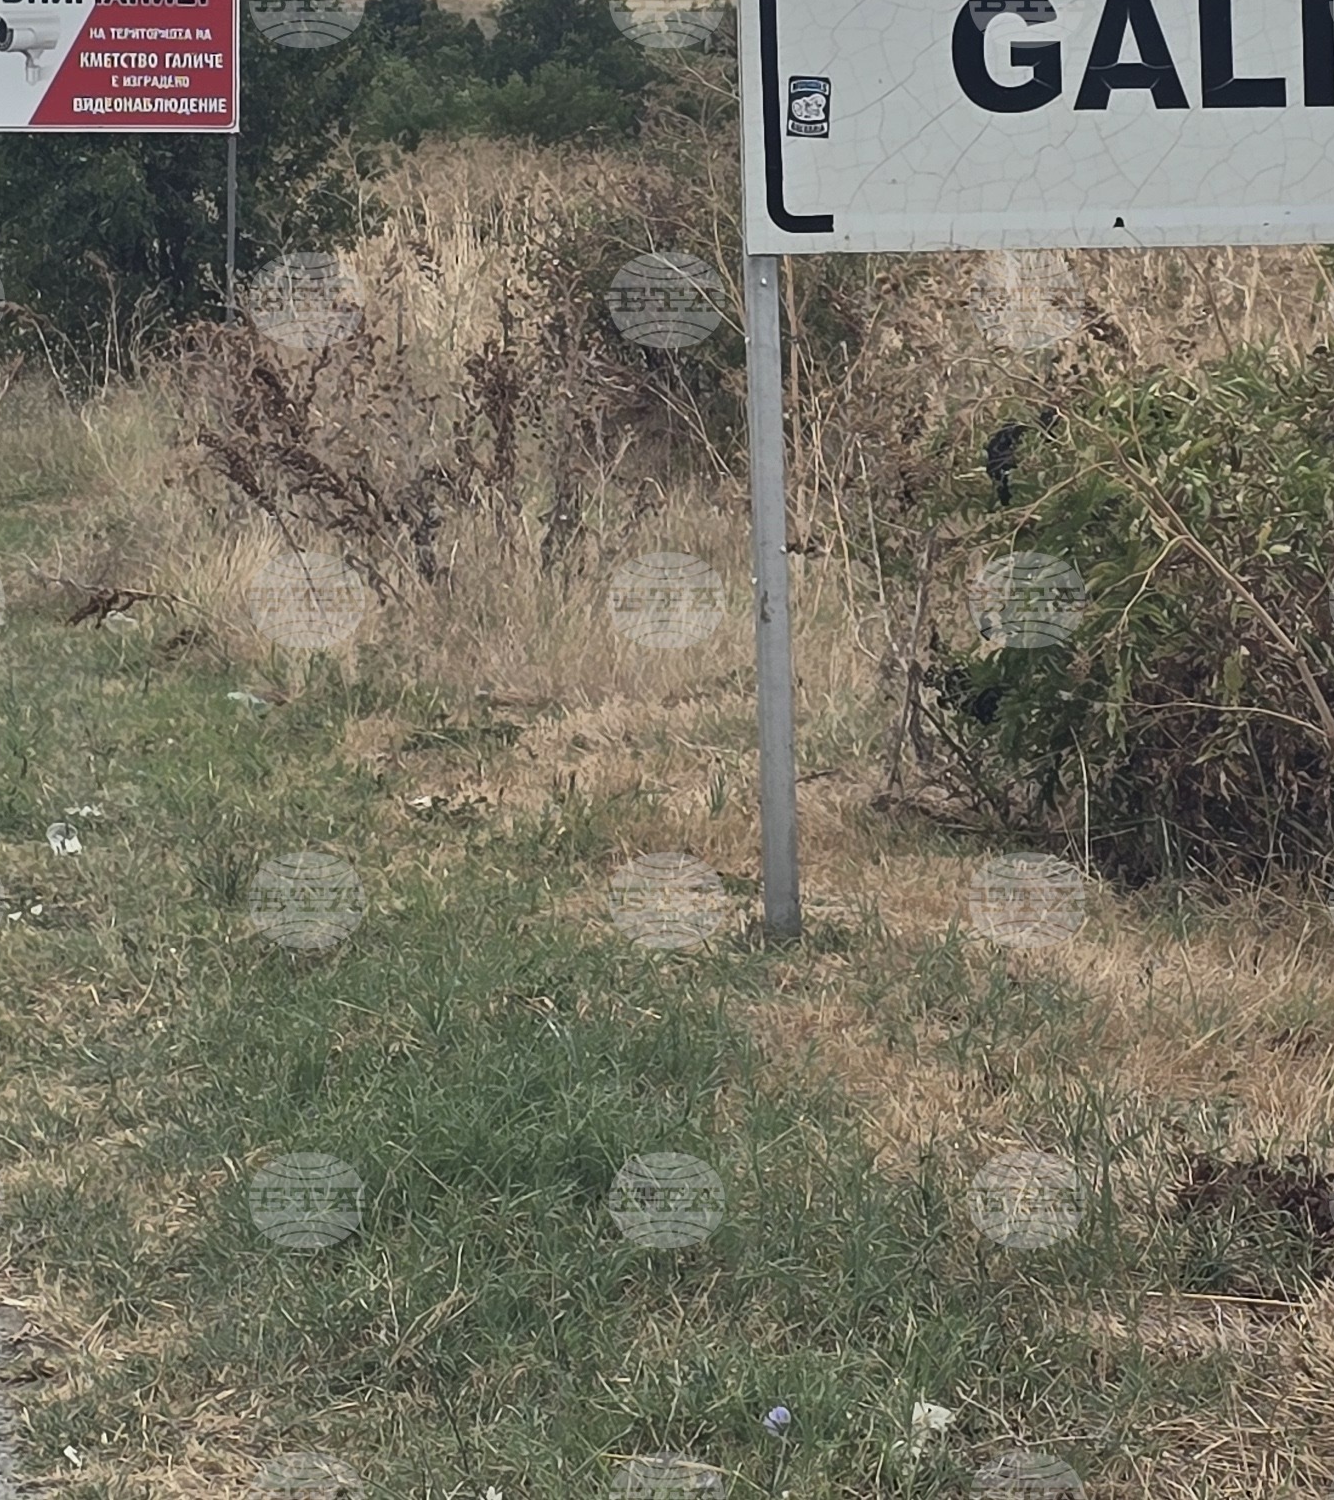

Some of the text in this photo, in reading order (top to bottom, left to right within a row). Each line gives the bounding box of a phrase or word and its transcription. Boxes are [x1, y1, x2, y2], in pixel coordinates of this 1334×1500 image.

[89, 27, 105, 40] НА
[196, 28, 212, 41] НА
[80, 52, 224, 69] КМЕТСТВО ГАЛИЧЕ
[111, 75, 190, 89] Е ИЗГРАДЕНО
[73, 97, 227, 116] ВИДЕОНАБЛЮДЕНИЕ
